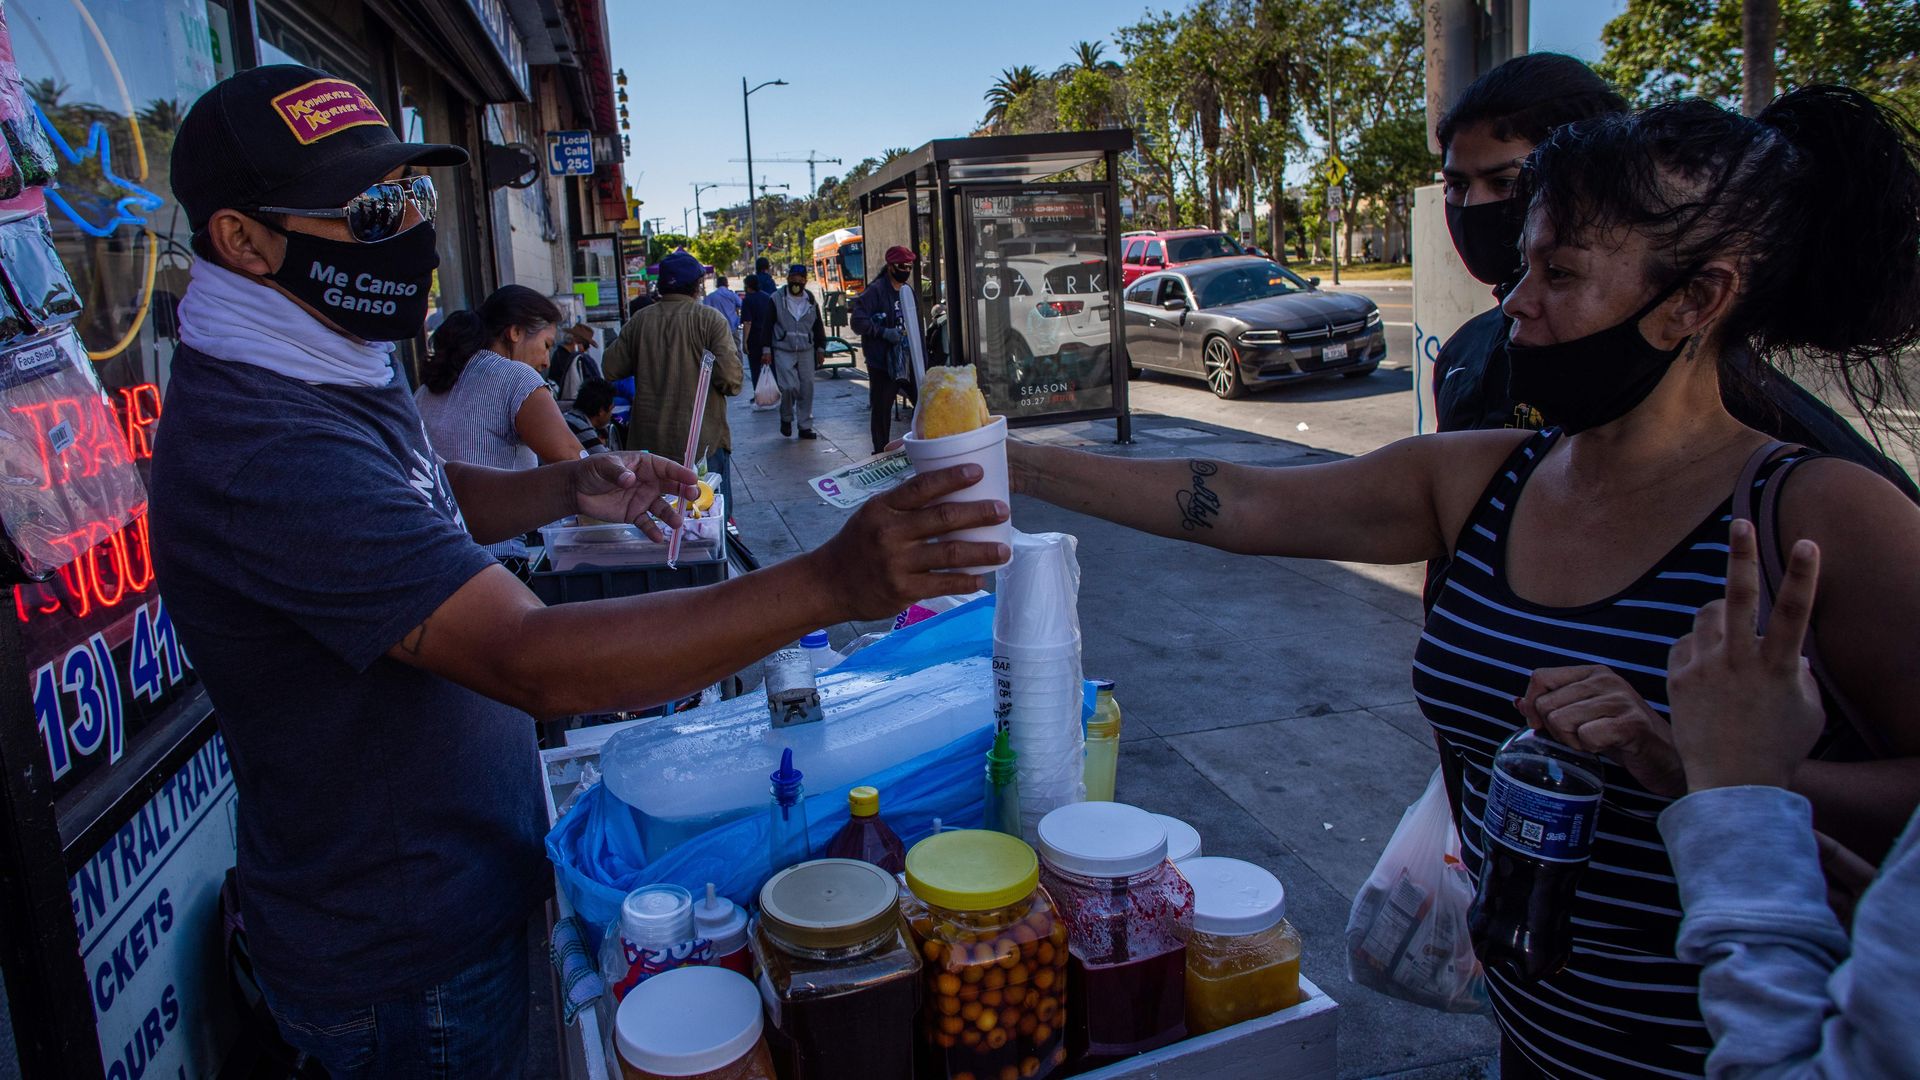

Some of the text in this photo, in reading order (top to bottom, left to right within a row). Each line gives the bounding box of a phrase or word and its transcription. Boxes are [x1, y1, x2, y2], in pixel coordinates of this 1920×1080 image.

[562, 134, 589, 145] Local
[564, 146, 589, 156] Calls
[309, 260, 418, 297] Me Canso
[982, 273, 1102, 302] OZARK
[323, 287, 397, 315] Ganso
[17, 347, 55, 368] Face Shield
[1021, 382, 1068, 396] SEASON
[1020, 396, 1045, 407] 03.27
[817, 478, 841, 497] 5
[129, 594, 194, 703] 41
